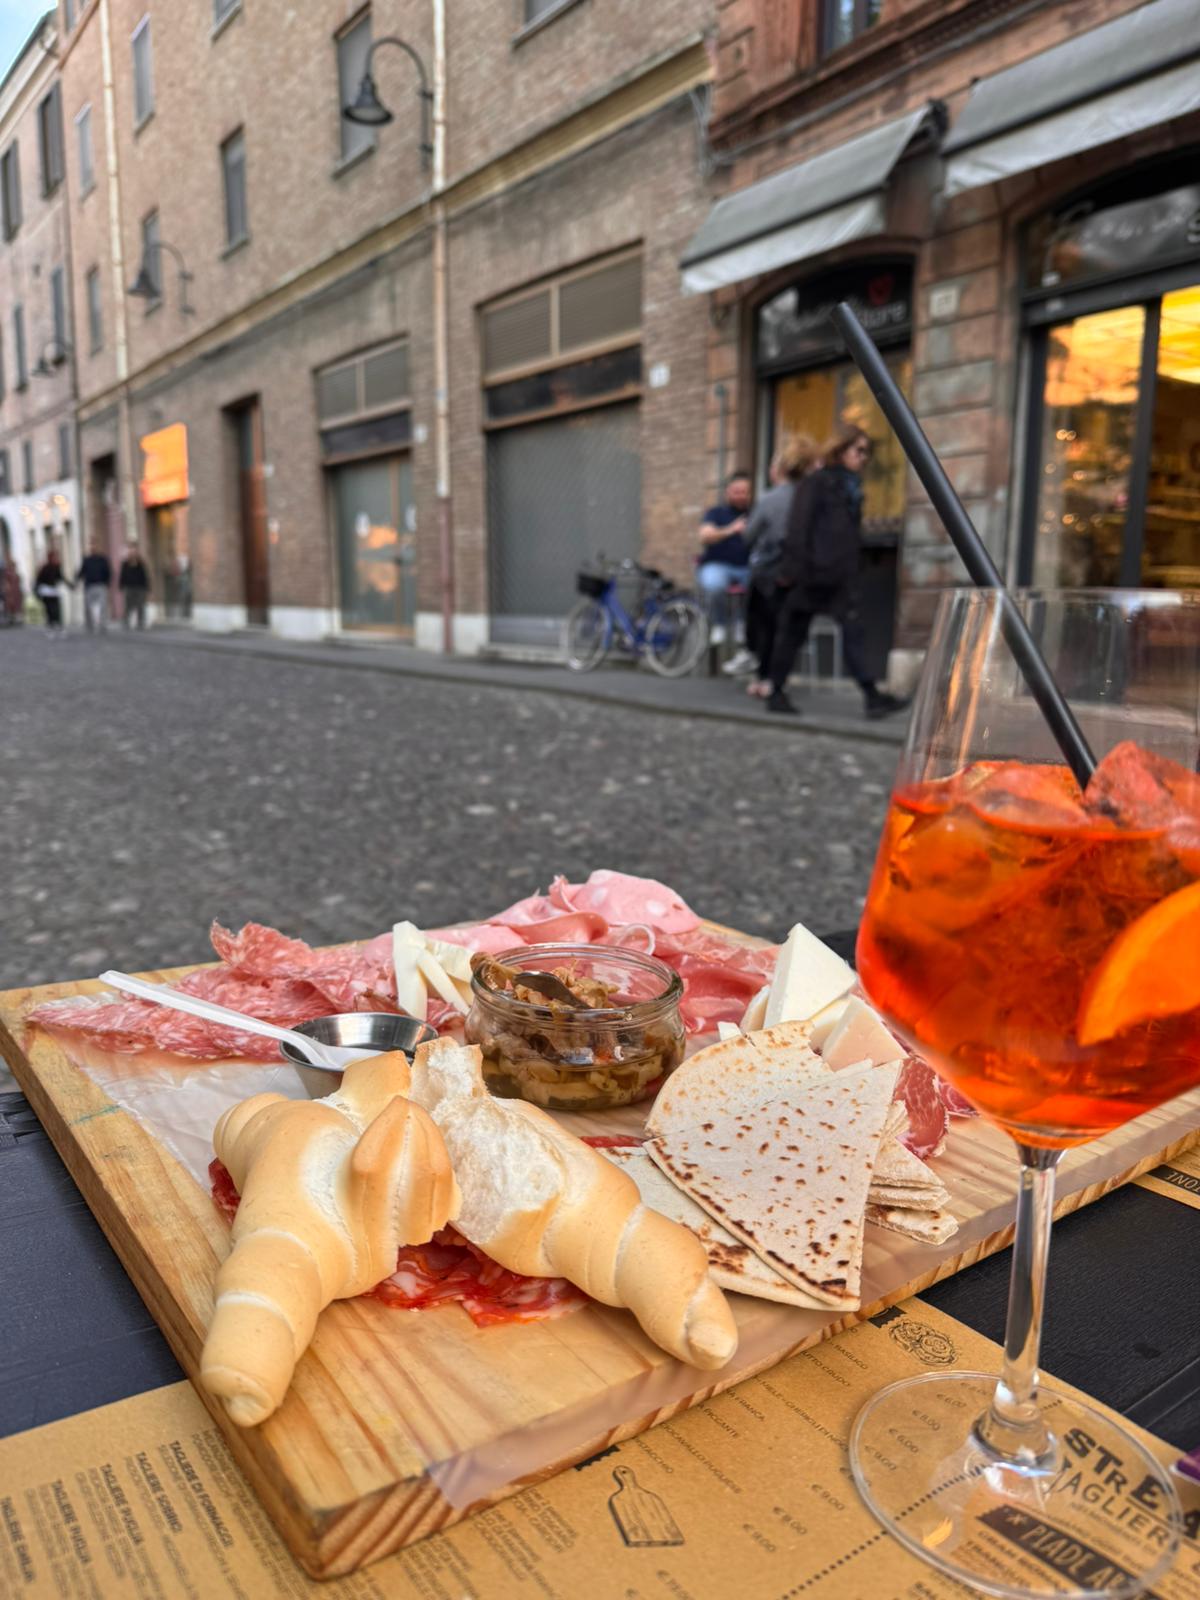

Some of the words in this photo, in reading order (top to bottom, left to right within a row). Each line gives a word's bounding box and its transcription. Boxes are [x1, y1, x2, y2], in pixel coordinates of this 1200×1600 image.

[133, 1450, 164, 1495] TAGLIERE
[168, 1439, 199, 1483] TAGLIERE
[99, 1462, 128, 1508] TAGLIERE
[191, 1480, 205, 1494] DI
[197, 1491, 235, 1549] FORMAGGI
[1019, 1524, 1096, 1575] PIADE
